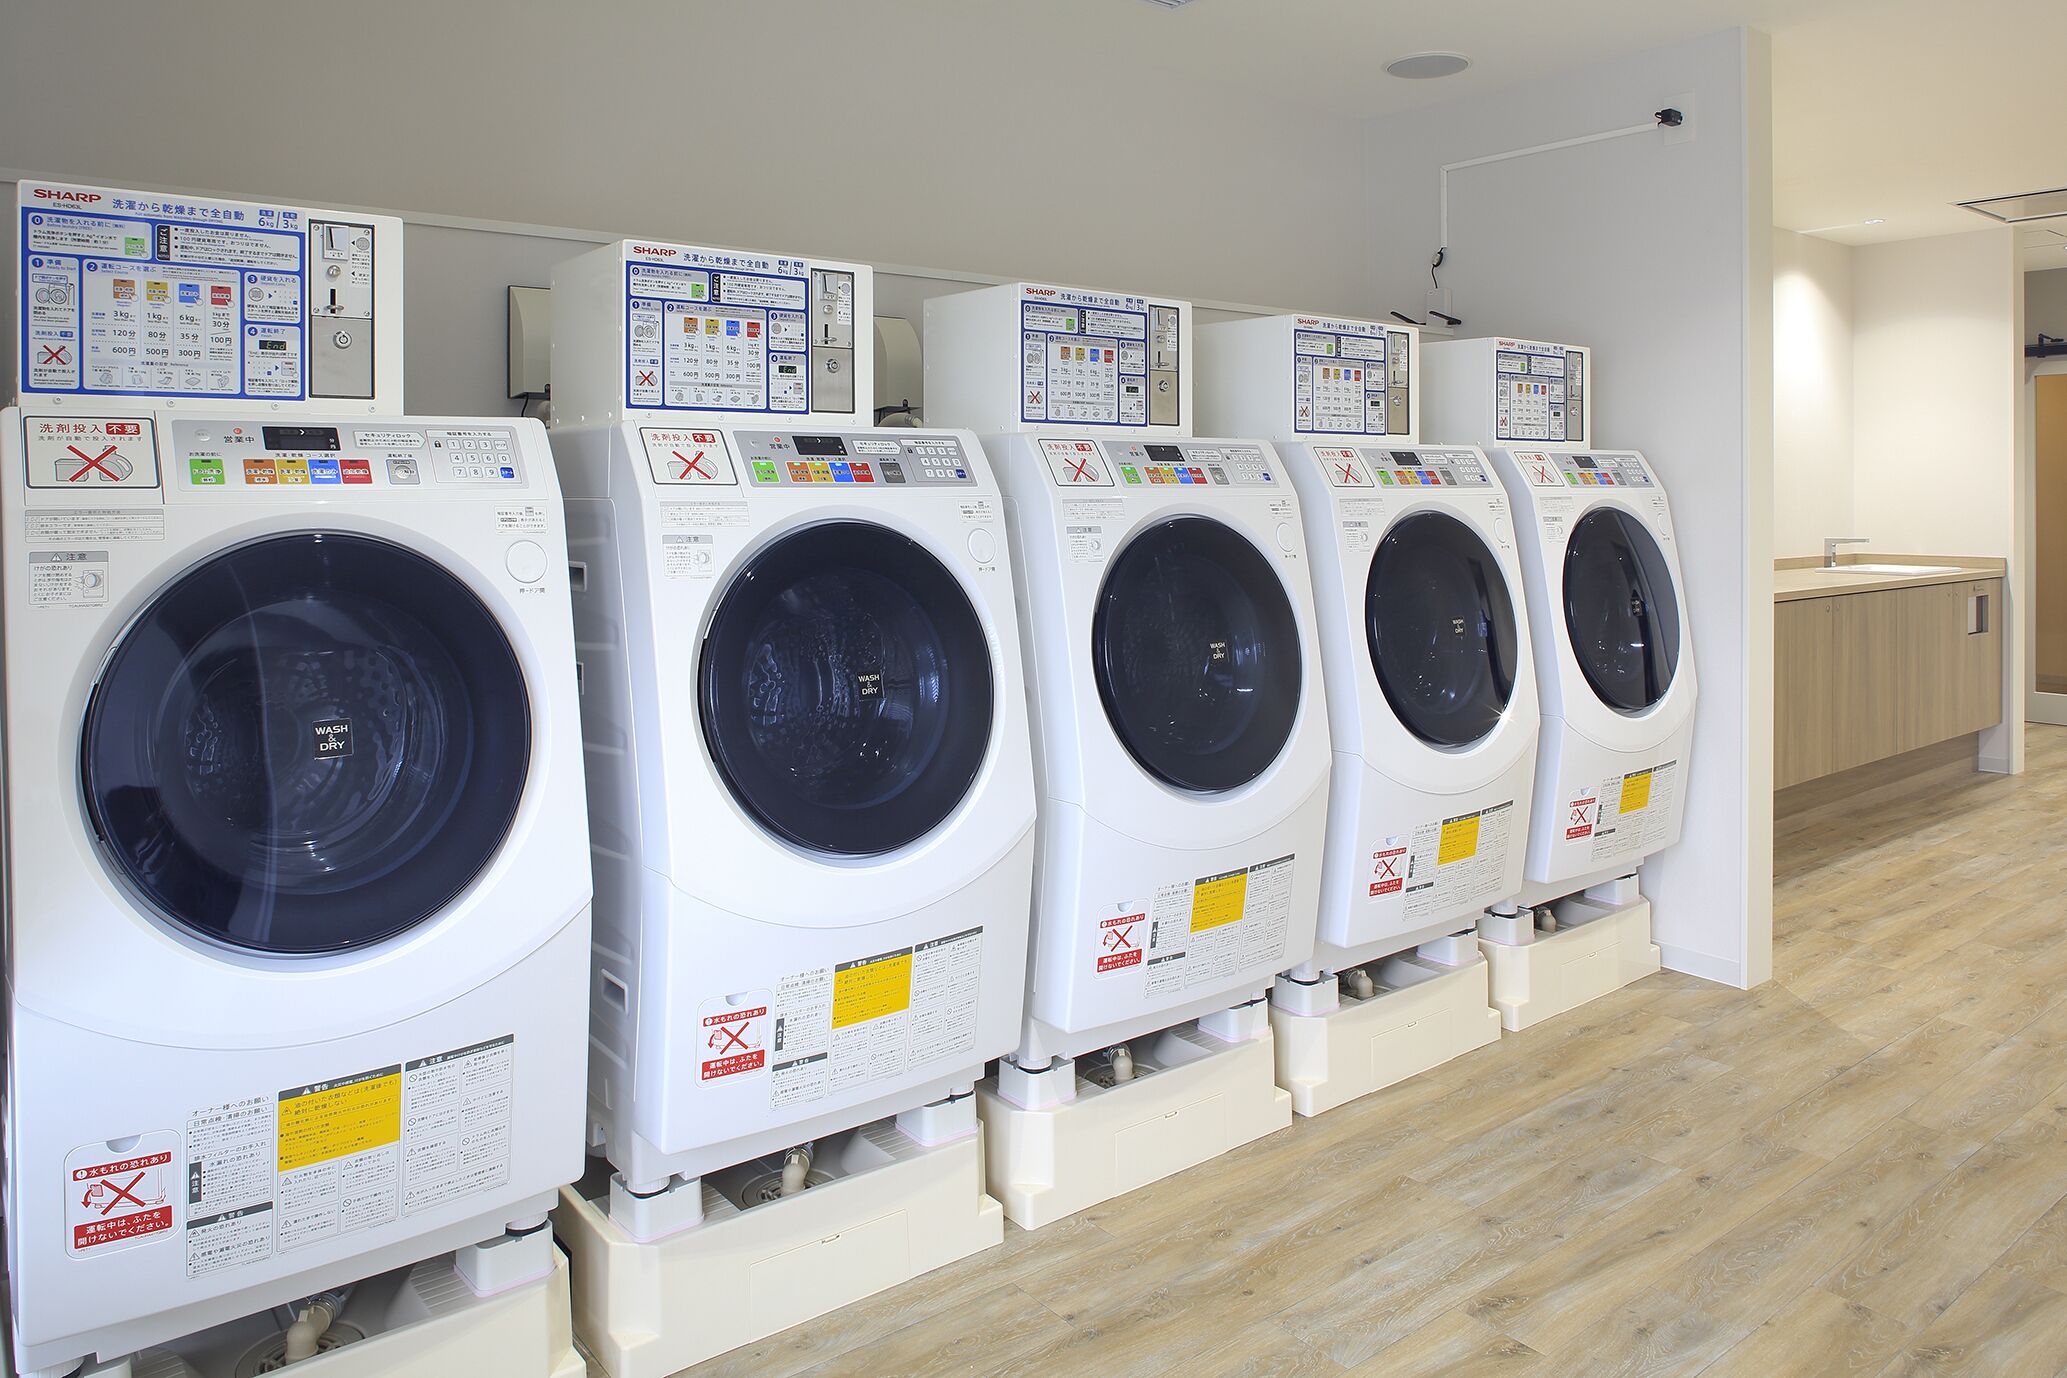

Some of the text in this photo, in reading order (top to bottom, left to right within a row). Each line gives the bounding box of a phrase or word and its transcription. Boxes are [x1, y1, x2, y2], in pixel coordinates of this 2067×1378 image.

[33, 188, 102, 203] SHARP
[112, 198, 245, 221] 洗濯から乾燥まで全自動
[633, 246, 677, 257] SHARP
[683, 252, 769, 270] 洗濯から乾燥まで全自動
[1025, 287, 1056, 297] SHARP
[212, 320, 230, 329] 30分
[1297, 318, 1319, 326] SHARP
[112, 329, 136, 338] 120分
[147, 331, 167, 340] 80分
[180, 333, 199, 341] 35分
[210, 336, 233, 345] 100円
[112, 347, 136, 356] 600円
[145, 348, 169, 356] 500円
[178, 350, 201, 358] 300円
[39, 423, 138, 434] 洗剤投入 不要
[66, 553, 87, 561] 注意
[858, 674, 880, 682] WASH
[861, 687, 878, 695] DRY
[315, 724, 348, 735] WASH
[328, 734, 336, 742] &
[320, 740, 345, 751] DRY
[89, 1153, 168, 1177] 水もれの恐れあり
[85, 1211, 161, 1234] 運転中は、ふたを
[77, 1220, 169, 1246] 開けないでください。
